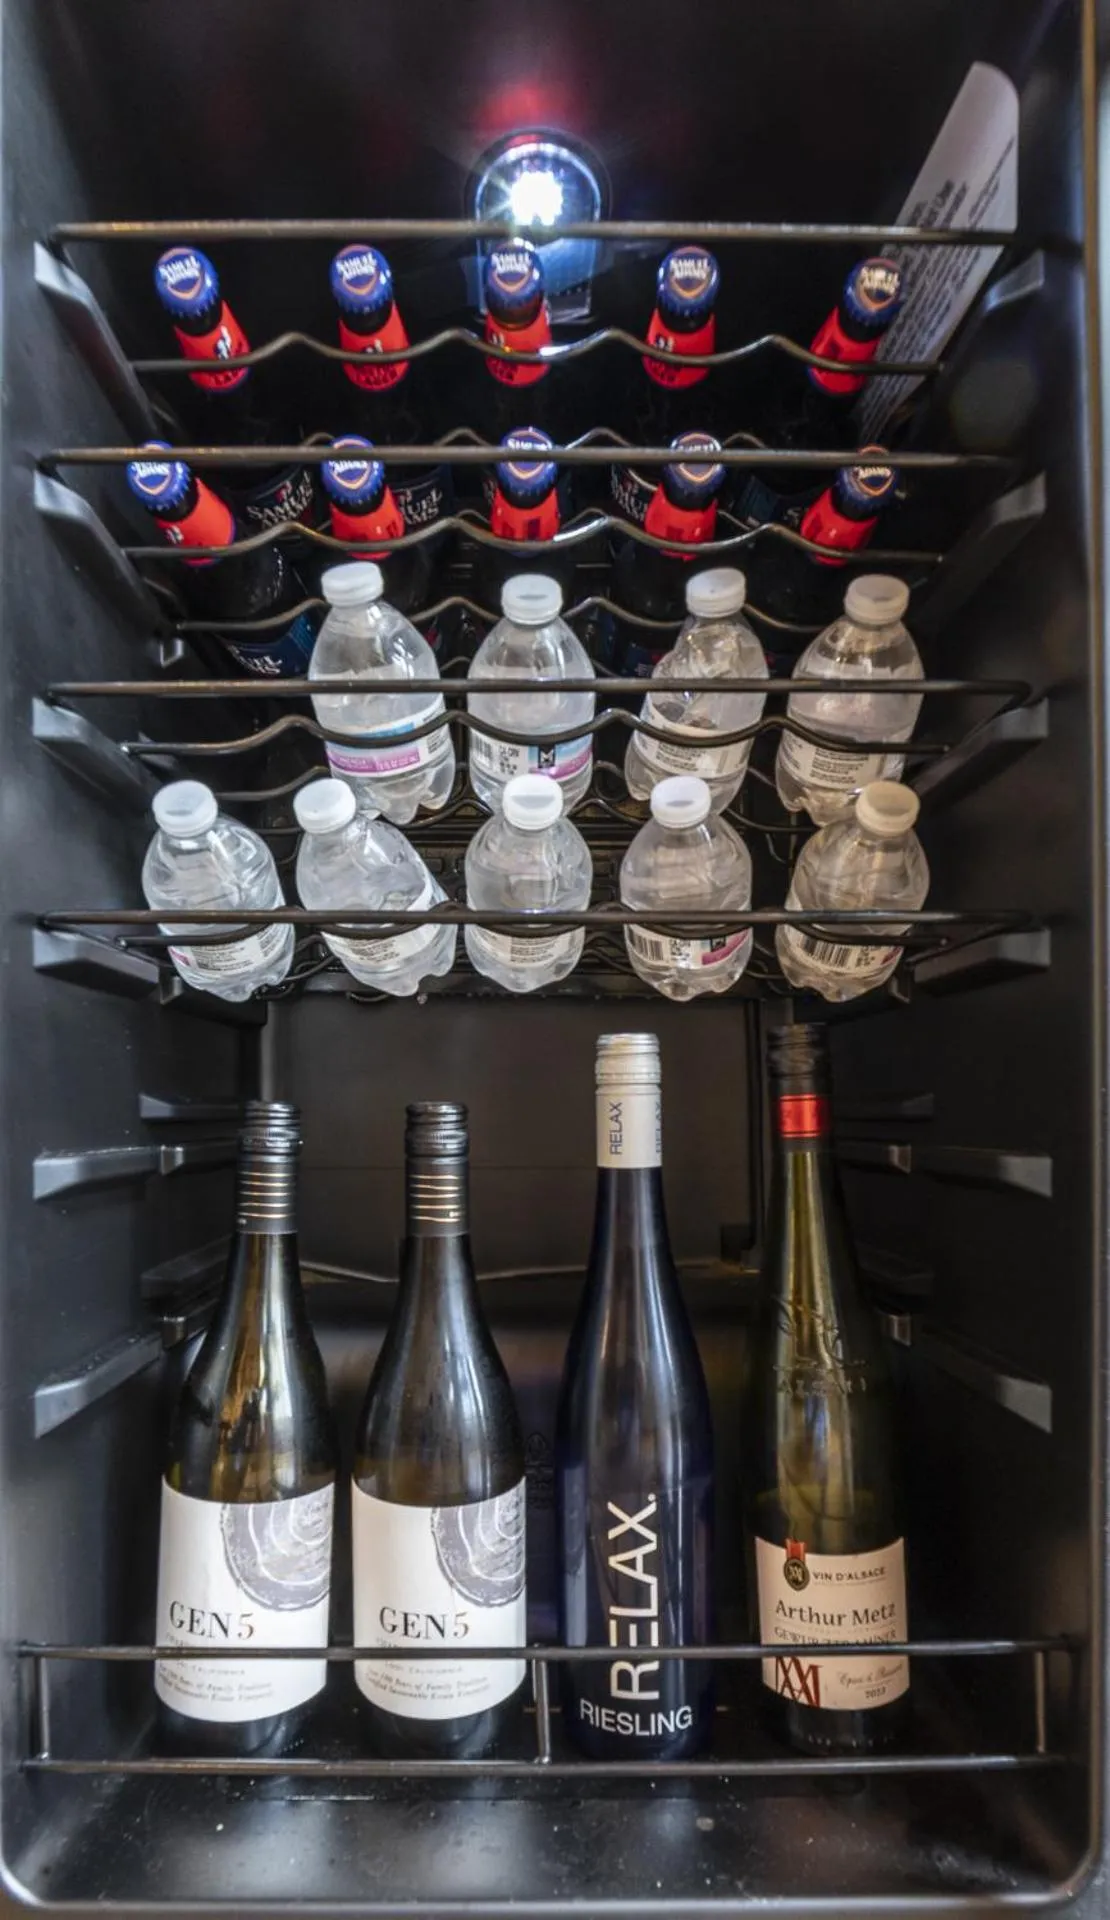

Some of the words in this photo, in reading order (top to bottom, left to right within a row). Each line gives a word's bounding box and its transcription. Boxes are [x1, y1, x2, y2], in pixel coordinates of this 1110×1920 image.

[608, 1101, 623, 1155] RELAX
[812, 1571, 833, 1582] VIN
[775, 1599, 847, 1627] Arthur
[852, 1603, 897, 1627] Metz
[580, 1698, 692, 1736] RIESLING
